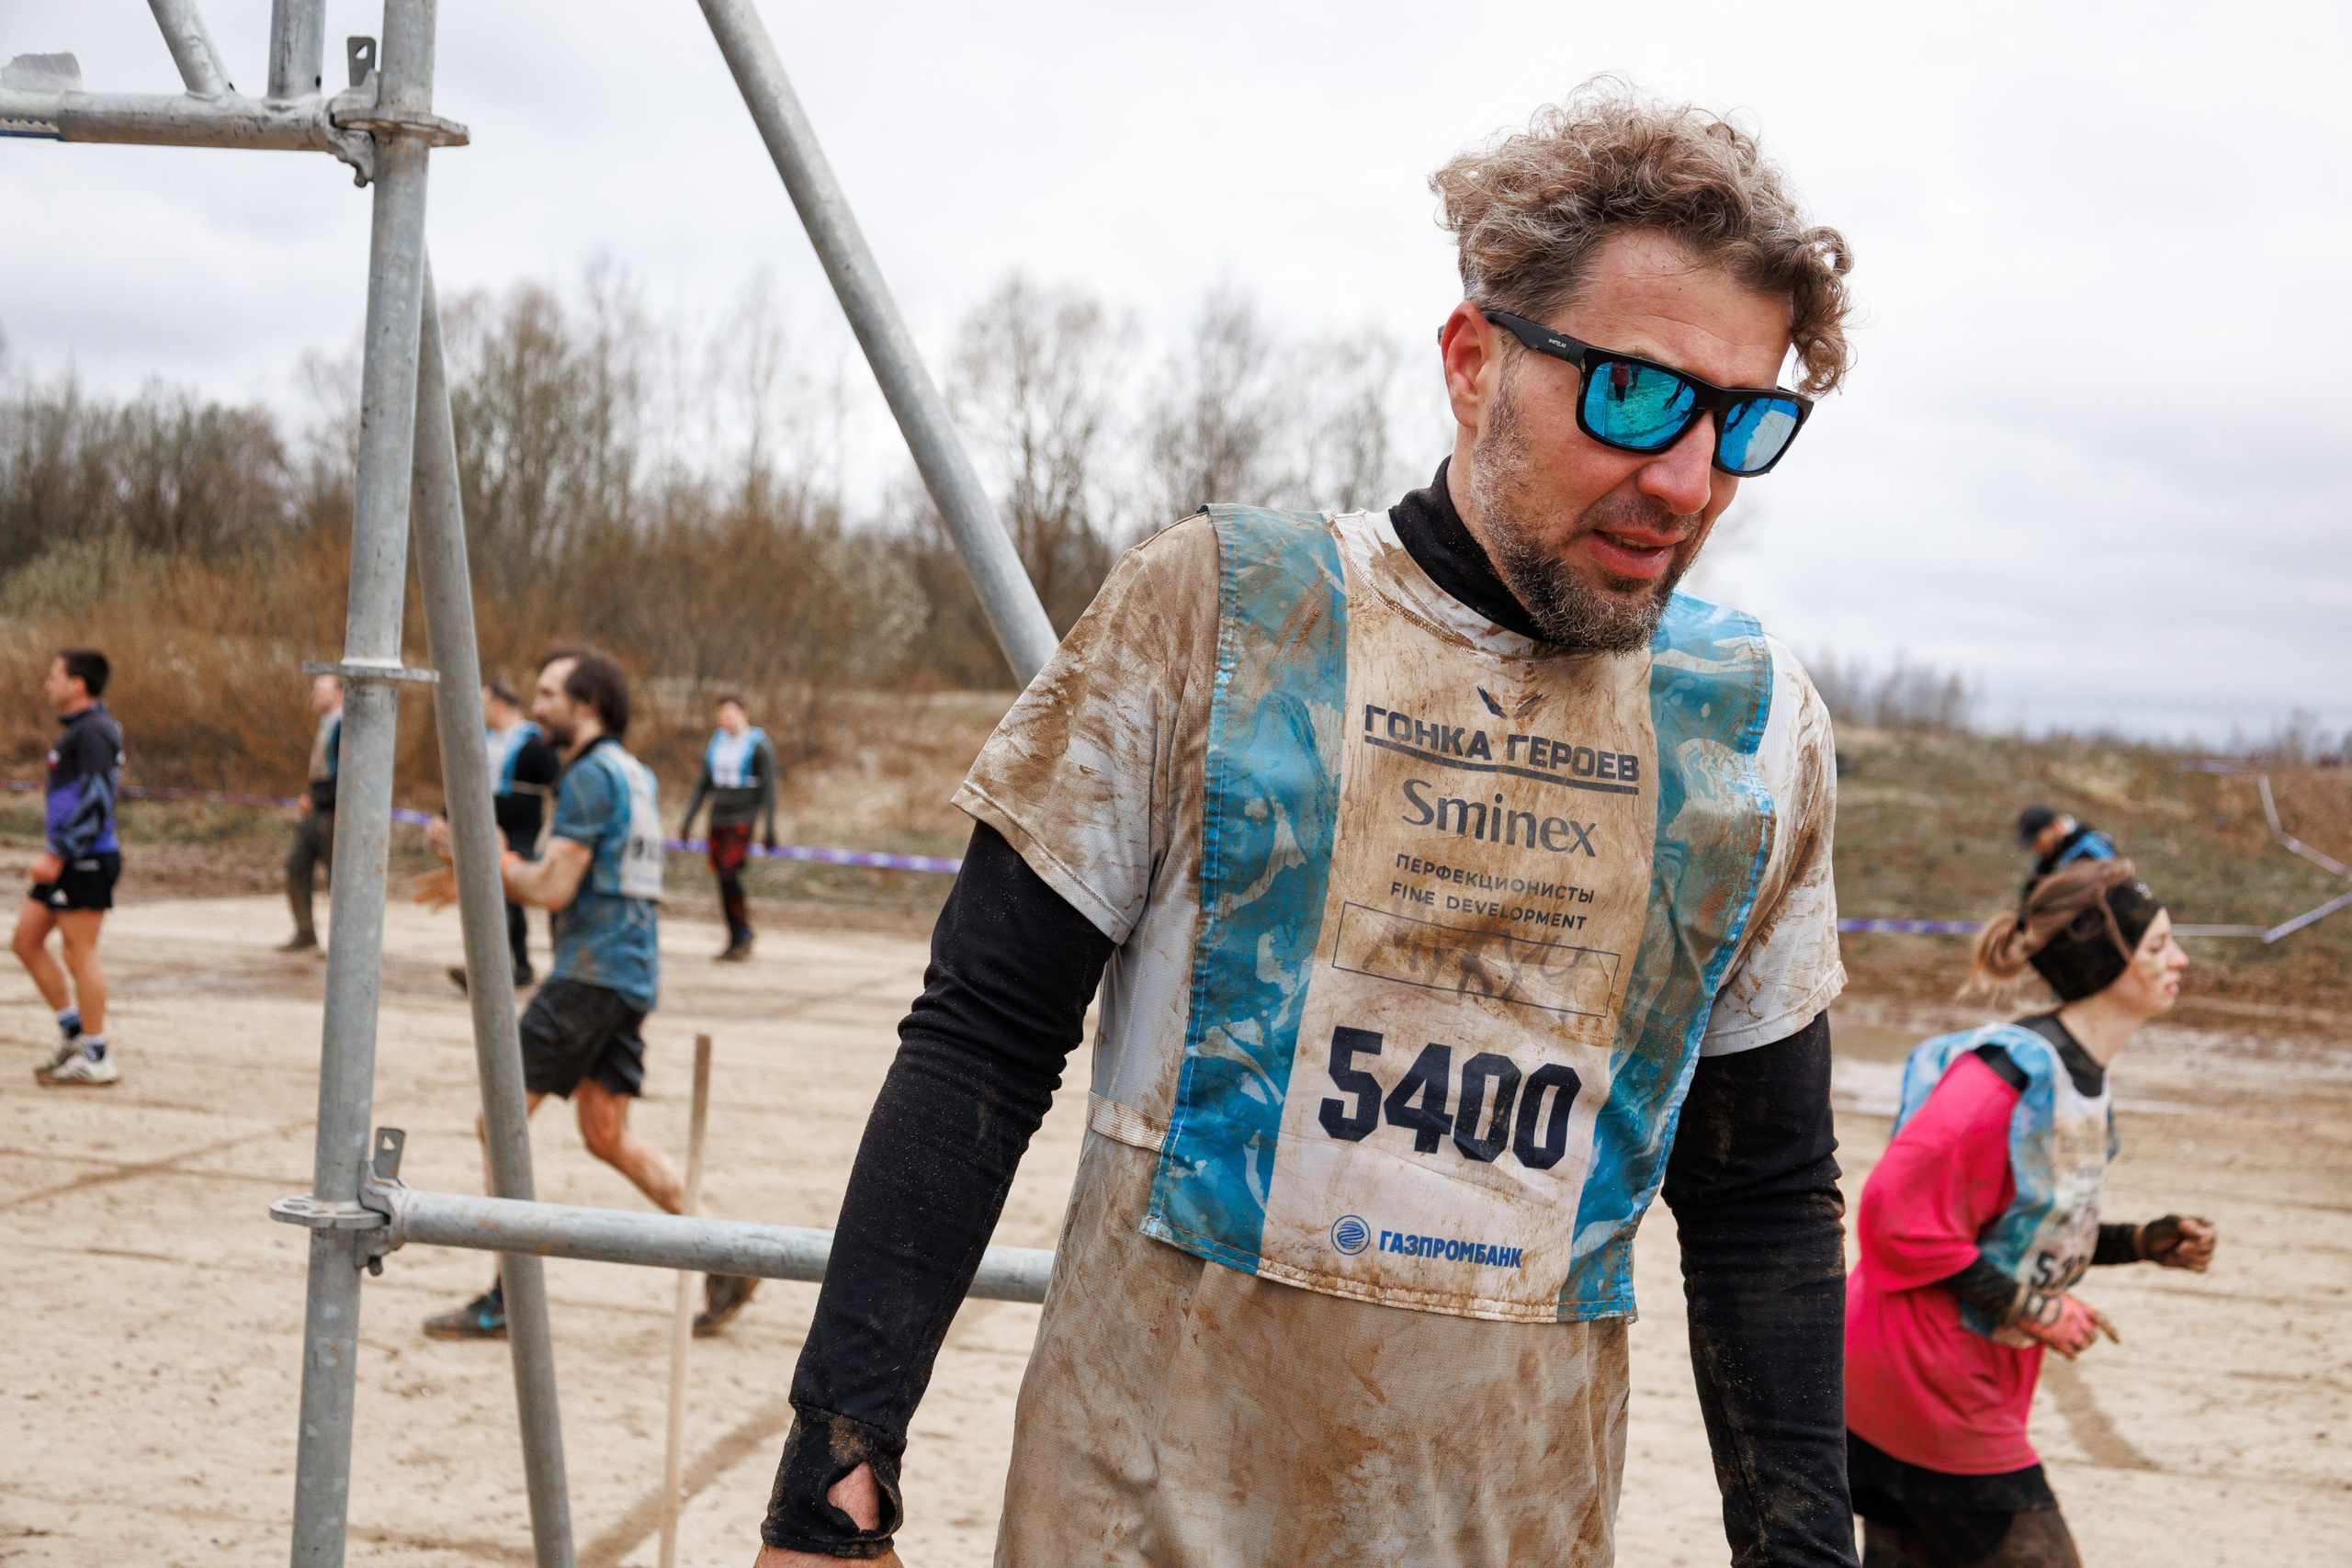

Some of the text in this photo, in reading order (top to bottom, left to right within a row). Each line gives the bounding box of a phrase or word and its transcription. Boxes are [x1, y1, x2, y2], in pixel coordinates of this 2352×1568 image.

[1364, 705, 1640, 782] ГОНКА ГЕРОЕВ
[1402, 778, 1597, 858] Sminex
[1390, 882, 1588, 931] FINE DEVELOPMENT
[1396, 853, 1595, 904] ПЕРФЕКЦИОНИСТЫ
[1318, 1025, 1582, 1170] 5400
[1379, 1230, 1523, 1269] ГАЗПРОМБАНК
